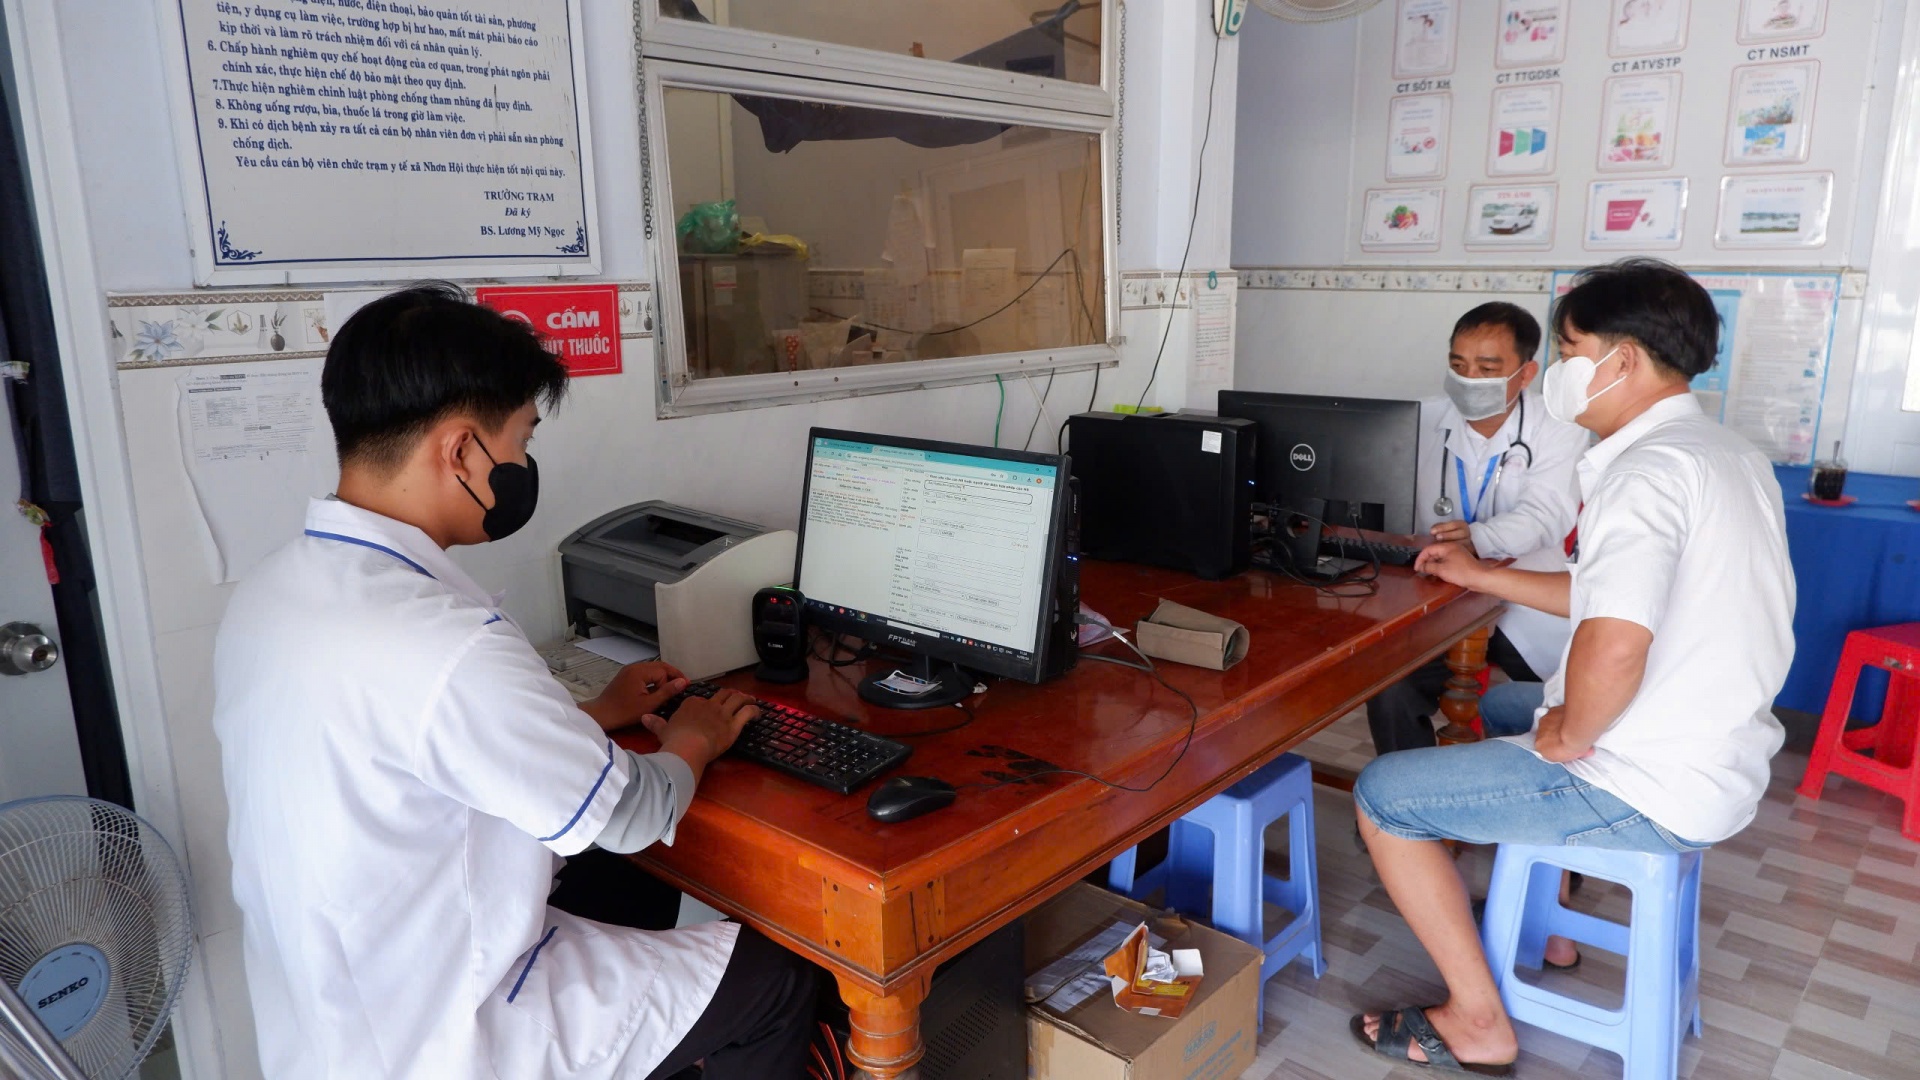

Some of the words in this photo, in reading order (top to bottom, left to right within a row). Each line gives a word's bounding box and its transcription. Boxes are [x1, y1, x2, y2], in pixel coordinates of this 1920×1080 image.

[217, 2, 242, 17] tiện,
[245, 8, 252, 18] y
[255, 4, 282, 21] dụng
[285, 12, 298, 23] cụ
[300, 10, 320, 23] làm
[322, 12, 346, 27] việc,
[347, 16, 380, 31] trường
[382, 20, 401, 34] hợp
[403, 22, 412, 35] bị
[414, 22, 427, 35] hư
[429, 24, 448, 38] hao,
[449, 26, 467, 39] mất
[469, 30, 485, 41] mát
[487, 32, 506, 46] phải
[508, 34, 523, 45] báo
[525, 36, 539, 47] cáo
[367, 0, 388, 14] điện
[390, 2, 416, 17] thoại,
[418, 6, 435, 18] bảo
[437, 8, 459, 23] quản
[461, 10, 473, 23] tốt
[475, 14, 487, 24] tài
[489, 14, 506, 28] sản,
[507, 18, 537, 33] phương
[219, 20, 238, 36] kịp
[240, 22, 262, 36] thời
[265, 26, 277, 37] và
[280, 26, 300, 39] làm
[316, 30, 343, 43] trách
[345, 34, 375, 48] nhiệm
[377, 36, 392, 48] đối
[411, 40, 421, 51] cá
[423, 42, 446, 54] nhân
[448, 44, 470, 58] quản
[472, 46, 482, 60] lý.
[208, 40, 217, 52] 6.
[221, 40, 248, 57] Chấp
[251, 44, 278, 57] hành
[281, 46, 318, 62] nghiêm
[321, 52, 339, 64] quy
[342, 50, 358, 64] chế
[362, 54, 383, 68] hoạt
[385, 56, 408, 70] động
[410, 58, 426, 69] của
[429, 62, 439, 71] cơ
[441, 64, 464, 75] quan,
[467, 64, 489, 77] trong
[491, 66, 510, 79] phát
[533, 70, 550, 83] phải
[1748, 50, 1765, 60] CT
[1770, 45, 1810, 58] NSMT
[223, 60, 253, 74] chính
[255, 62, 277, 77] xác,
[279, 64, 303, 79] thực
[305, 66, 328, 81] hiện
[330, 66, 347, 81] chế
[350, 70, 362, 83] độ
[364, 72, 382, 83] bảo
[384, 74, 402, 87] mật
[404, 74, 424, 87] theo
[426, 80, 442, 90] quy
[445, 78, 467, 91] định.
[1496, 73, 1510, 84] CT
[1515, 69, 1560, 82] TTGDSK
[1612, 62, 1628, 73] CT
[1632, 57, 1681, 71] ATVSTP
[252, 82, 276, 95] hiện
[279, 84, 316, 98] nghiêm
[349, 88, 368, 102] luật
[370, 90, 399, 105] phòng
[401, 90, 428, 106] chống
[431, 94, 452, 106] tham
[496, 100, 510, 112] quy
[513, 100, 533, 113] định.
[1396, 84, 1410, 93] CT
[216, 98, 226, 110] 8.
[228, 98, 263, 114] Không
[265, 100, 292, 116] uống
[293, 104, 321, 117] rượu,
[323, 104, 341, 117] bia,
[343, 104, 370, 118] thuốc
[372, 108, 382, 118] lá
[384, 110, 409, 122] trong
[411, 110, 425, 123] giờ
[427, 110, 444, 122] làm
[445, 112, 466, 125] việc.
[218, 118, 228, 129] 9.
[230, 118, 250, 130] Khi
[252, 120, 264, 131] có
[267, 120, 290, 134] dịch
[291, 120, 318, 134] bệnh
[340, 126, 352, 134] ra
[353, 122, 368, 135] tất
[369, 124, 381, 136] cả
[383, 126, 400, 137] cán
[401, 126, 413, 139] bộ
[415, 128, 438, 139] nhân
[439, 128, 459, 140] viên
[461, 130, 477, 141] đơn
[478, 130, 487, 143] vị
[489, 132, 507, 144] phải
[525, 134, 539, 144] sàn
[540, 134, 564, 148] phòng
[233, 136, 265, 152] chống
[268, 138, 293, 152] dịch.
[236, 156, 258, 168] Yêu
[261, 154, 279, 168] cầu
[282, 156, 300, 168] cán
[302, 156, 315, 170] bộ
[317, 158, 339, 169] viên
[342, 158, 364, 170] chức
[366, 160, 389, 173] trạm
[391, 164, 397, 174] y
[399, 160, 408, 172] tế
[423, 162, 447, 173] Nhơn
[449, 162, 464, 175] Hội
[466, 162, 485, 175] thực
[487, 164, 506, 176] hiện
[507, 164, 519, 175] tốt
[521, 166, 534, 177] nội
[535, 166, 548, 178] qui
[550, 168, 566, 179] này.
[484, 188, 525, 201] TRƯỞNG
[527, 192, 555, 204] TRẠM
[505, 208, 518, 217] Đã
[521, 208, 532, 219] ký
[481, 226, 496, 236] BS.
[499, 226, 527, 238] Lương
[544, 226, 566, 239] Ngọc
[546, 306, 600, 329] CẤM
[568, 331, 610, 356] THUỐC
[1293, 453, 1312, 462] DELL
[888, 634, 902, 642] FPT
[38, 977, 88, 1009] SENKO
